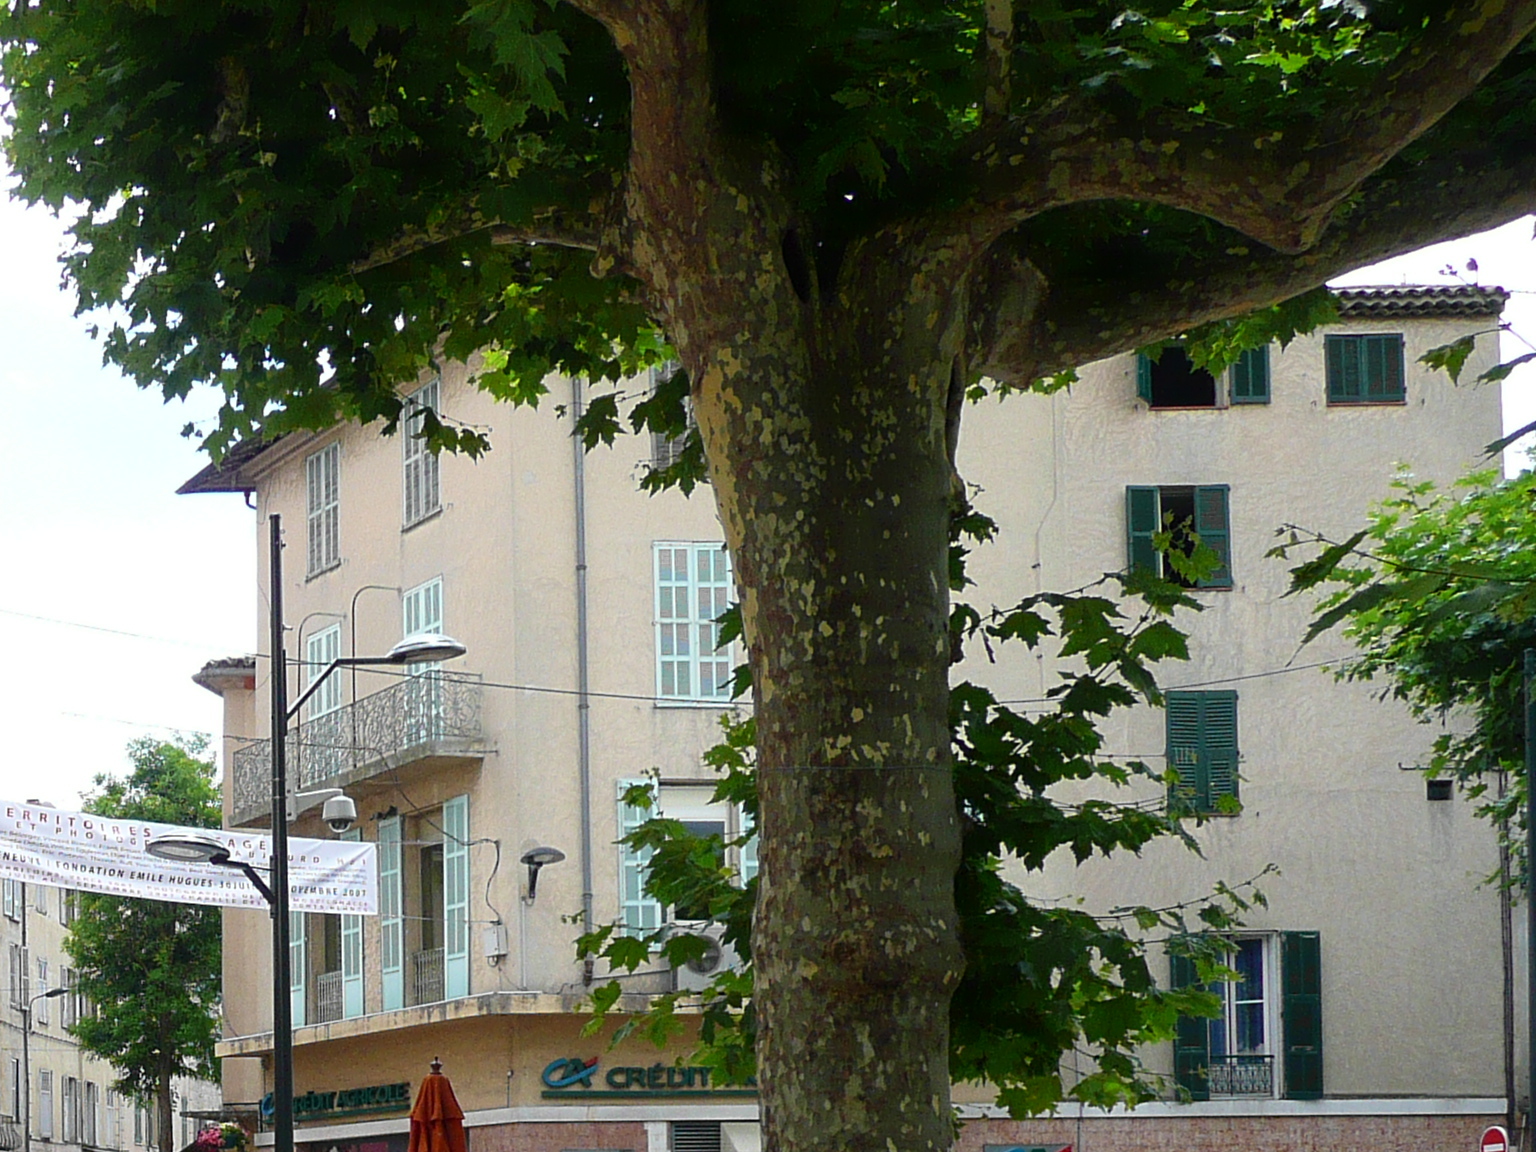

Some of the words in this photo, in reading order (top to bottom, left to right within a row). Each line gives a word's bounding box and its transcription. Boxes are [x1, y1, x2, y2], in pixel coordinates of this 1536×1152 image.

[16, 821, 37, 831] ET
[55, 860, 125, 878] FONDATION
[129, 870, 164, 883] EMILE
[168, 875, 213, 888] HUGUES
[290, 884, 339, 897] OVEMBRE
[606, 1062, 712, 1088] CRÉDIT
[293, 1090, 337, 1114] RÉDIT
[336, 1082, 411, 1109] AGRICOLE
